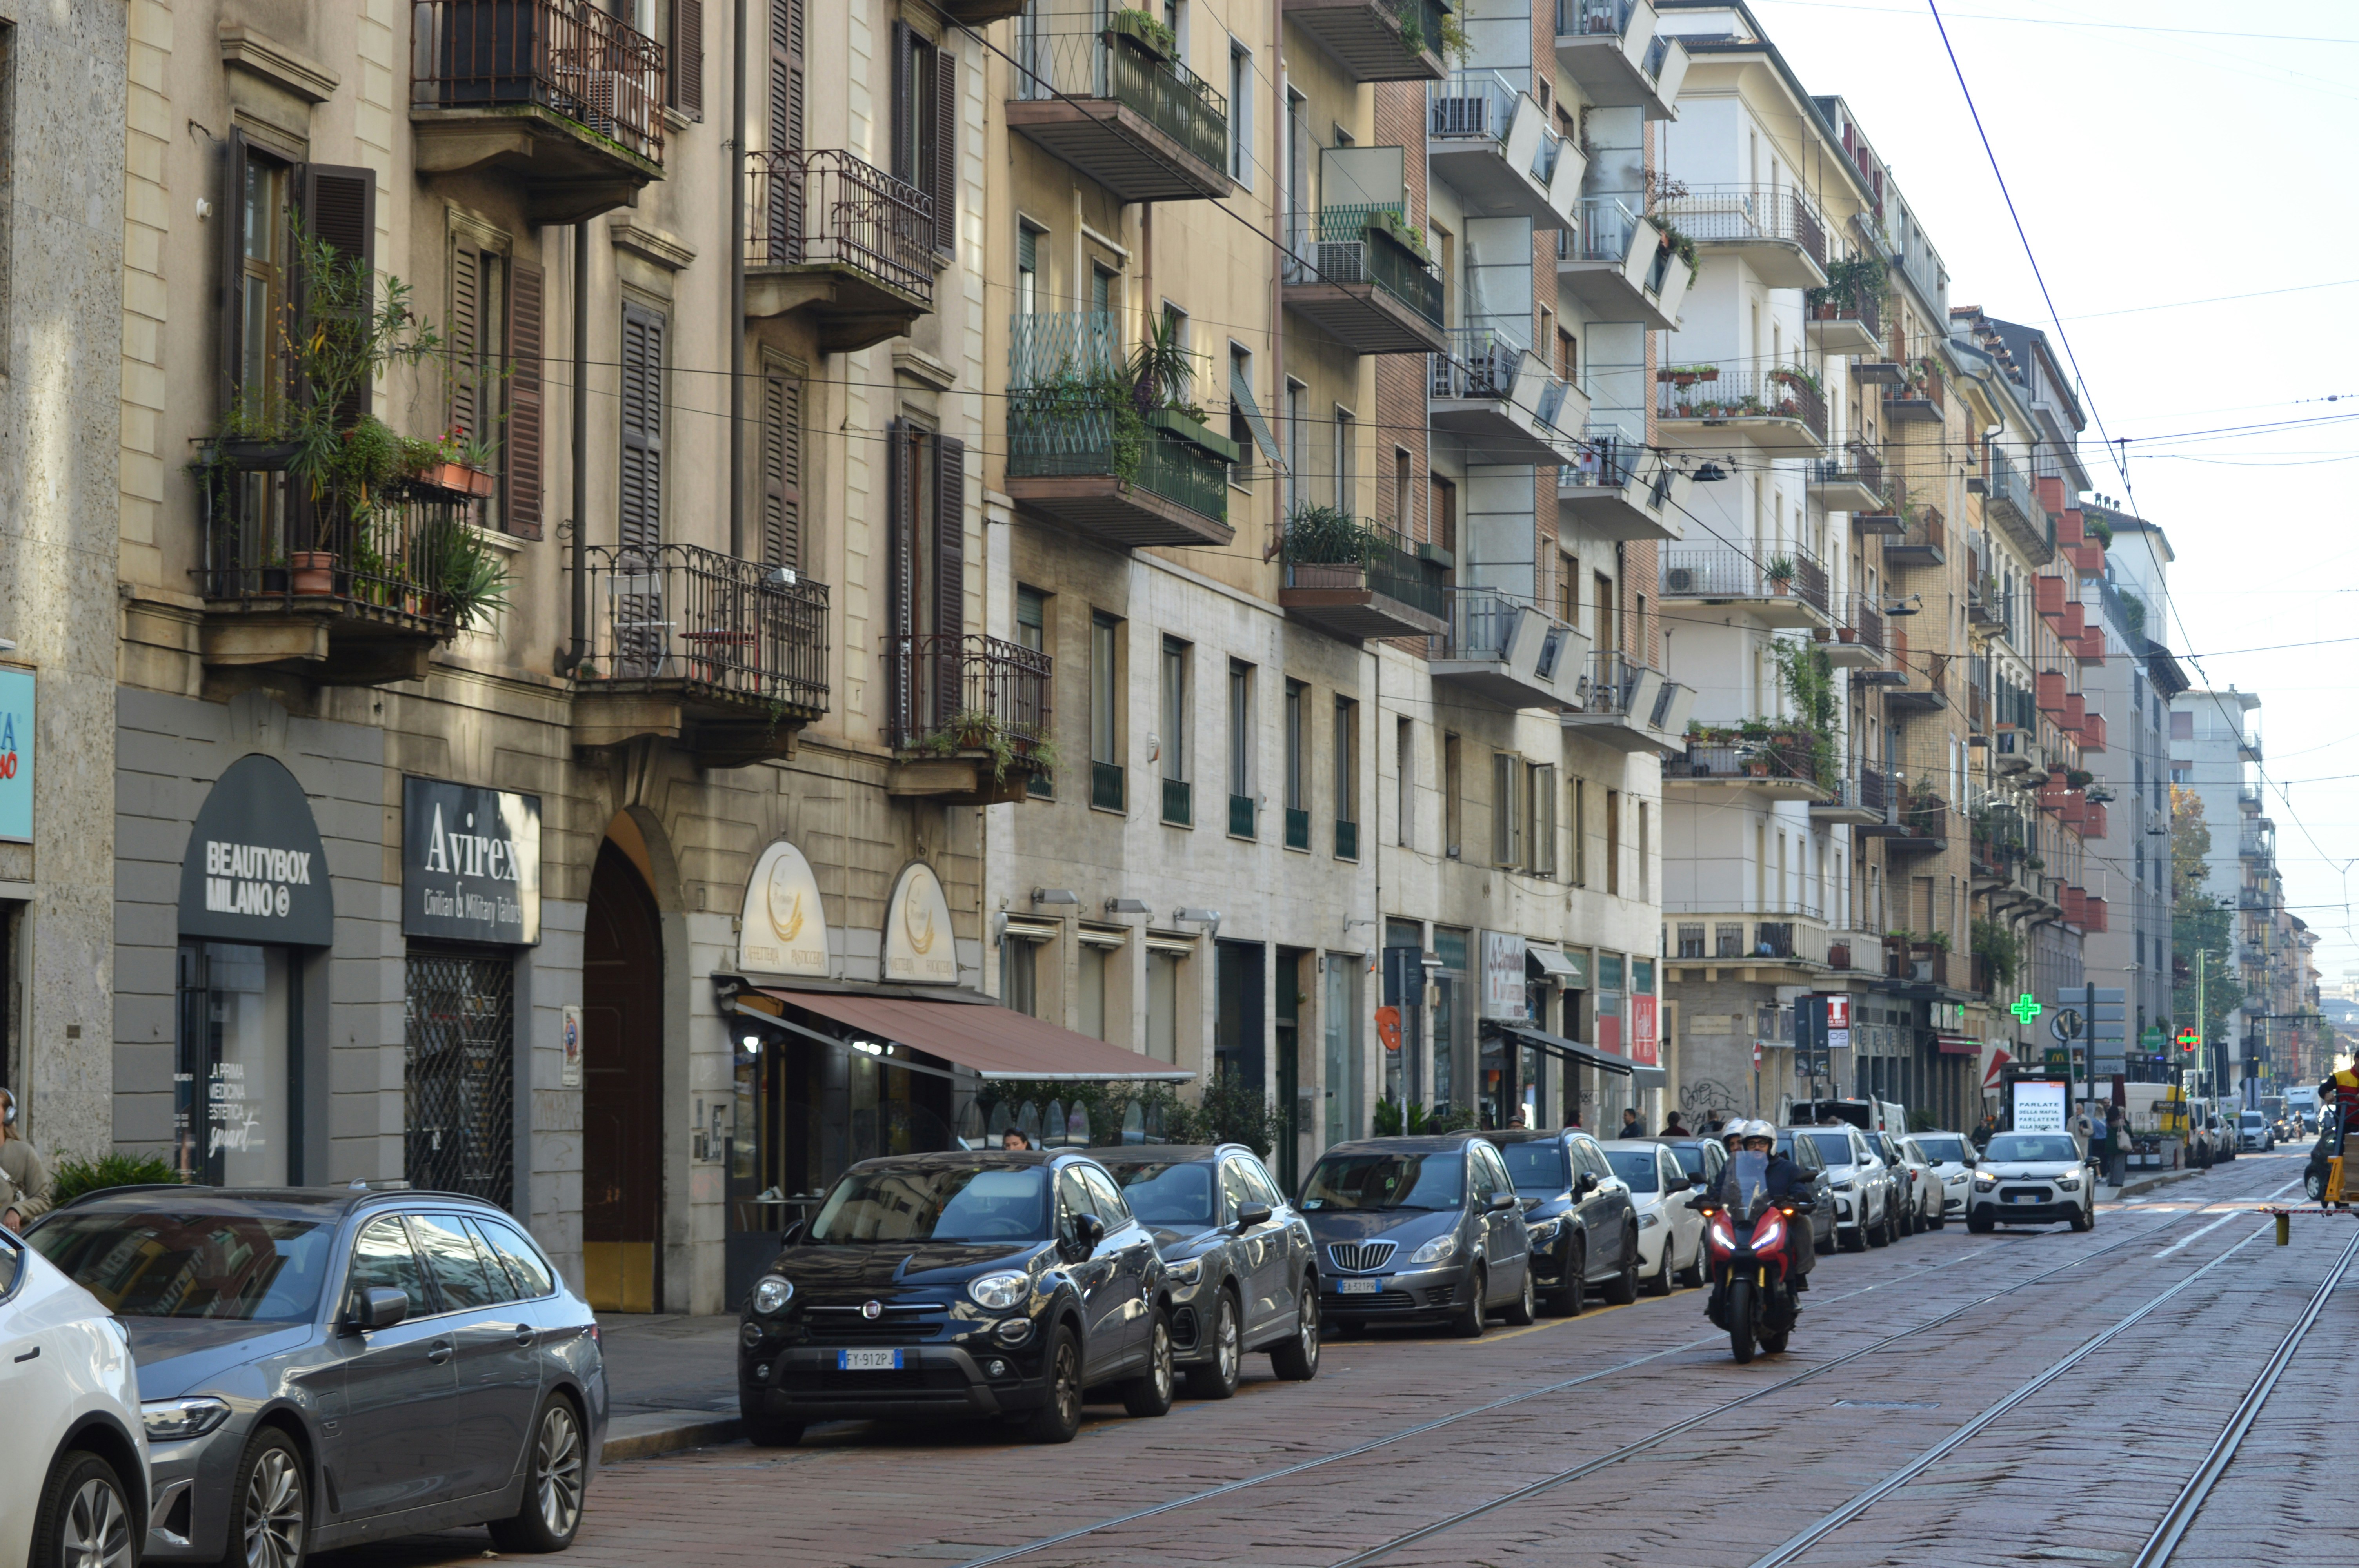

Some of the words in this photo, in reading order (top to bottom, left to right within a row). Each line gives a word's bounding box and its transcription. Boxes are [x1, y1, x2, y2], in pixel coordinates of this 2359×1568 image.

[0, 712, 17, 751] A
[207, 840, 311, 885] BEAUTYBOX
[425, 802, 520, 881] Avirex
[206, 877, 273, 917] MILANO
[424, 888, 454, 917] Civilian
[456, 881, 464, 918] &
[466, 893, 496, 927] Military
[497, 896, 522, 924] Tailors
[1827, 996, 1848, 1020] T
